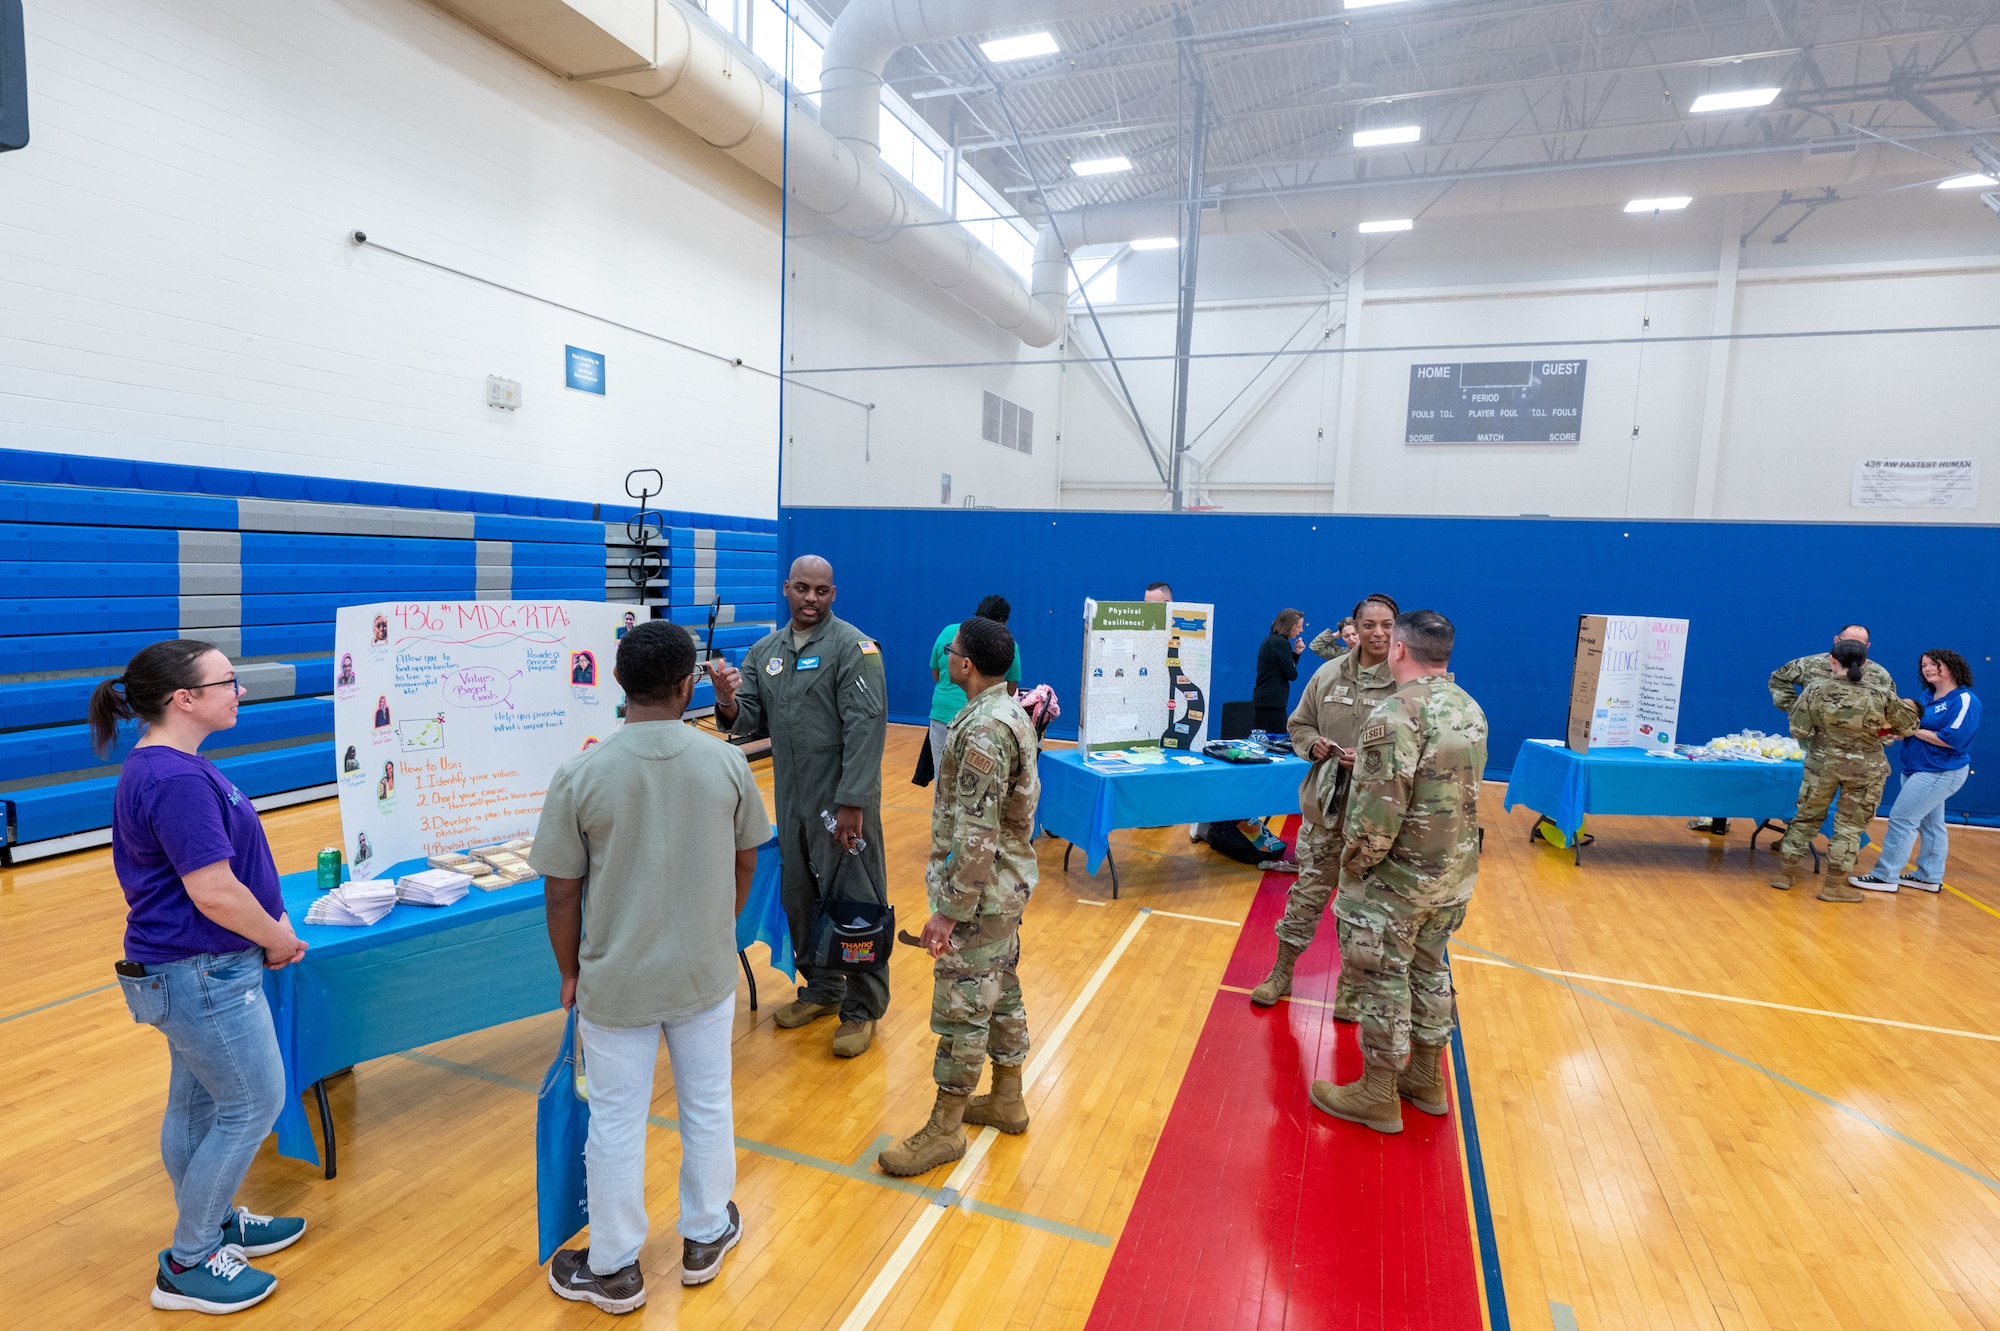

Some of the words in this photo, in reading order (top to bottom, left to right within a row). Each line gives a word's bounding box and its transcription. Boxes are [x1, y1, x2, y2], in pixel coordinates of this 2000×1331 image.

[1417, 366, 1451, 378] HOME
[1541, 362, 1580, 375] GUEST
[1471, 393, 1499, 402] PERIOD
[1411, 410, 1435, 419] FOULS
[1468, 409, 1495, 418] PLAYER
[1500, 409, 1519, 417] FOUL
[1552, 408, 1577, 417] FOULS
[1408, 434, 1434, 442] SCORE
[1477, 433, 1504, 442] MATCH
[1549, 432, 1577, 441] SCORE
[1938, 460, 1972, 468] HUMAN
[1108, 606, 1141, 616] Physical
[458, 604, 516, 631] MDG
[1103, 618, 1145, 627] Resilience!
[1606, 620, 1638, 640] NTRO
[1656, 639, 1671, 652] YOU
[396, 653, 422, 664] Allow
[424, 655, 437, 664] you
[442, 652, 451, 661] to
[550, 657, 558, 665] of
[395, 664, 411, 672] find
[395, 674, 405, 682] to
[458, 672, 495, 685] Values
[453, 683, 487, 696] Based
[472, 691, 498, 702] Goals
[494, 711, 515, 723] Help
[516, 712, 531, 721] you
[523, 719, 564, 730] important
[400, 761, 423, 774] How
[426, 758, 437, 771] to
[440, 756, 463, 771] Use:
[970, 752, 991, 771] TMO
[470, 773, 488, 785] your
[432, 790, 456, 805] Chart
[459, 792, 477, 803] your
[449, 801, 467, 810] How
[469, 796, 484, 807] will
[485, 798, 496, 806] you
[485, 810, 501, 821] plan
[503, 807, 512, 817] to
[515, 807, 543, 815] overcom
[467, 838, 490, 849] plans
[502, 828, 530, 840] needed
[840, 941, 874, 950] THANKS
